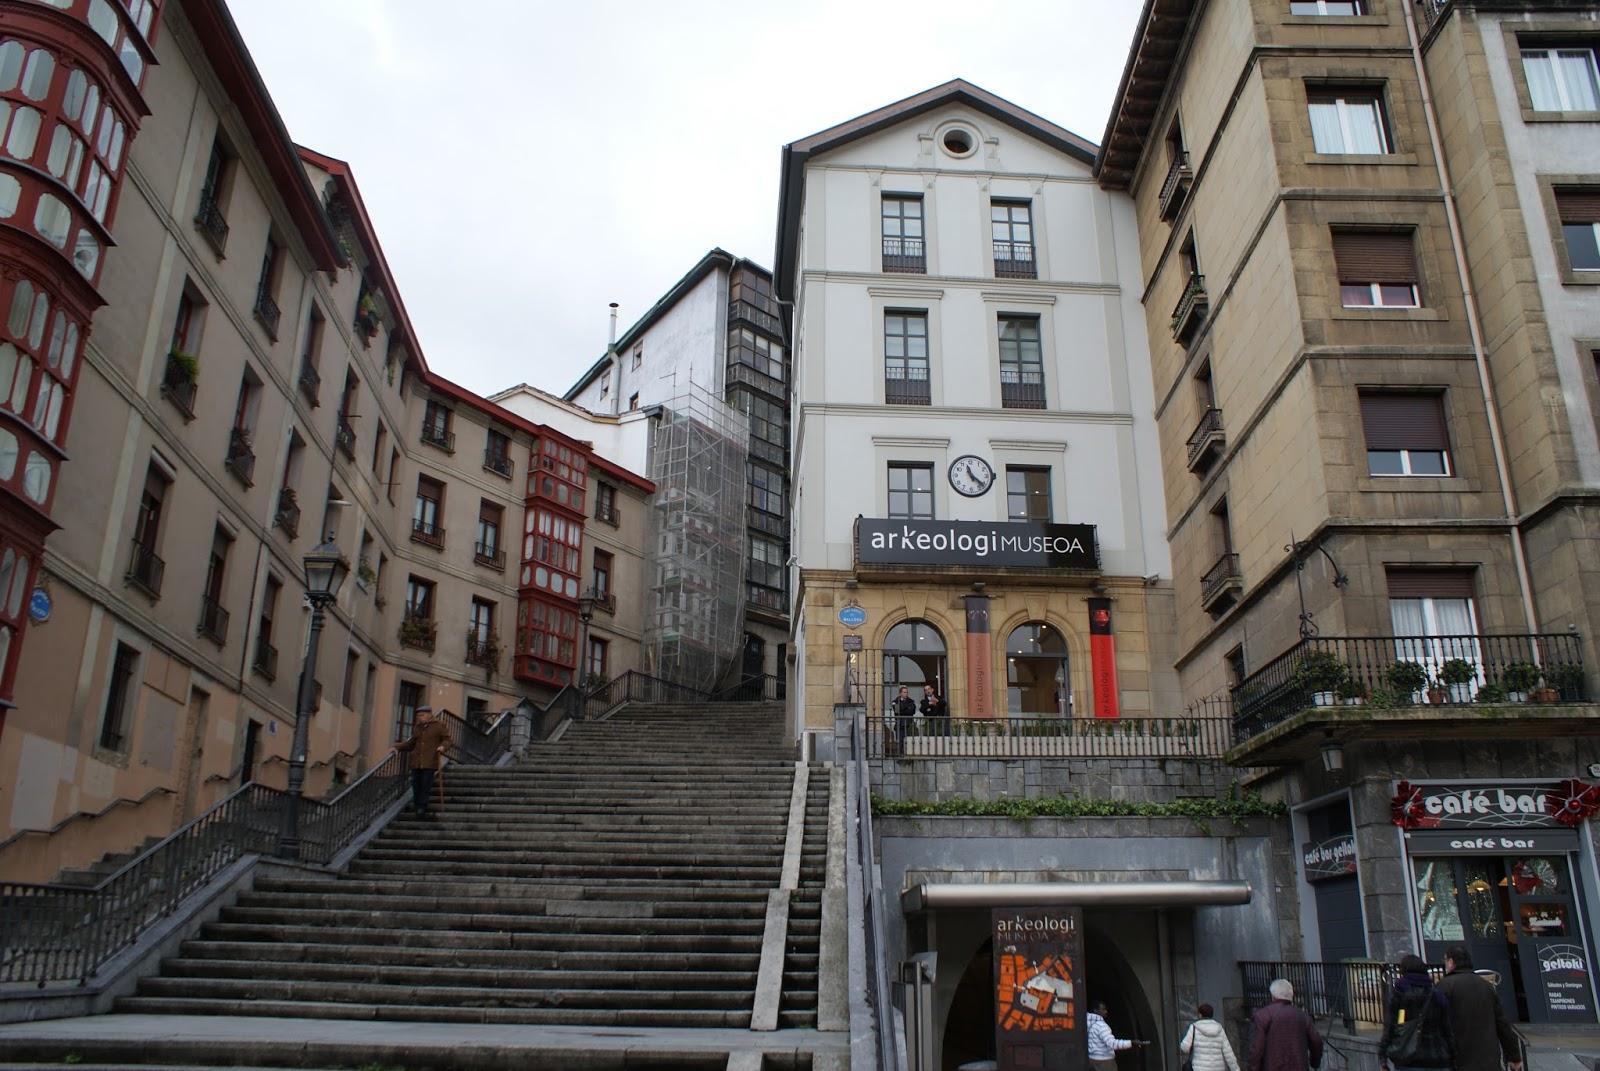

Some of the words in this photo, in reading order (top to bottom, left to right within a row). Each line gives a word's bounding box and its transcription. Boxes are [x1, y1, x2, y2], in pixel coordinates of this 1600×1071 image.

[871, 525, 997, 557] arkeologi
[1001, 535, 1085, 554] MUSEOA
[850, 653, 856, 664] 2
[1425, 789, 1491, 815] café
[1497, 789, 1547, 814] bar
[1450, 838, 1496, 849] café
[1500, 838, 1535, 849] bar
[998, 915, 1074, 934] arkeologi
[1543, 959, 1583, 971] geltoki
